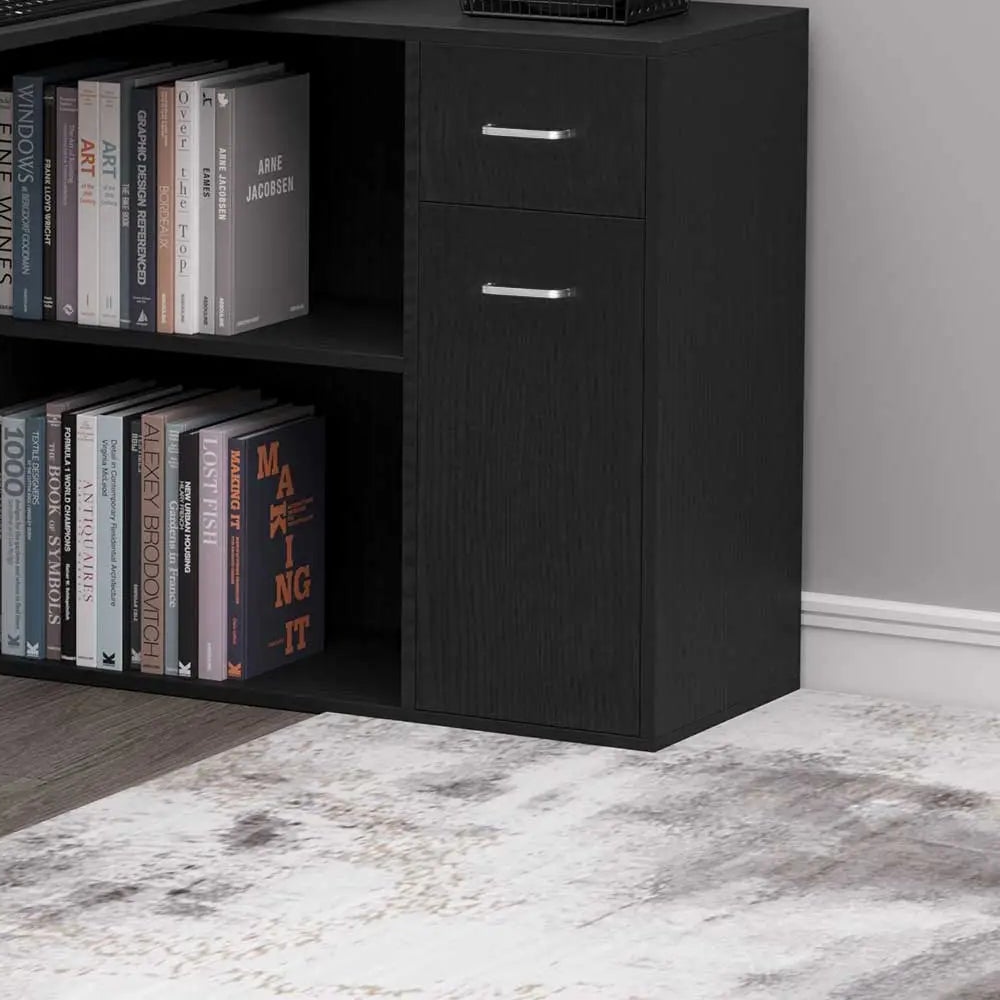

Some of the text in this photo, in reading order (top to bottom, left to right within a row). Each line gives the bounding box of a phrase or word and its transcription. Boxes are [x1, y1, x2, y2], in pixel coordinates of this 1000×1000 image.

[17, 84, 34, 183] WINDOWS
[81, 139, 96, 177] ART
[136, 110, 147, 161] GRAPHIC
[102, 140, 117, 179] ART
[178, 90, 189, 273] Over the Top
[202, 168, 211, 198] EAMES
[218, 147, 227, 221] ARNE JACOBSEN
[258, 154, 283, 176] ARNE
[43, 159, 52, 246] FRANK LLOYD WRIGHT
[121, 184, 130, 195] THE
[136, 165, 147, 207] DESIGN
[246, 176, 294, 203] JACOBSEN
[159, 185, 169, 249] BORDEAUX
[21, 234, 31, 275] GOODMAN
[136, 210, 147, 285] REFERENCED
[4, 427, 25, 497] 1000
[31, 431, 40, 505] TEXTILE DESIGNERS
[63, 427, 71, 466] FORMULA
[99, 439, 109, 497] Virginia McLeod
[110, 439, 118, 459] Detail
[48, 465, 60, 516] BOOK
[63, 474, 71, 503] WORLD
[108, 470, 118, 520] Contemporary
[202, 437, 218, 545] LOST FISH
[230, 450, 241, 510] MAKING
[63, 505, 71, 552] CHAMPIONS
[80, 480, 94, 603] ANTIQUAIRES
[110, 523, 118, 562] Residential
[143, 423, 160, 657] ALEXEY BRODOVITCH
[183, 481, 191, 573] NEW URBAN HOUSING
[230, 513, 241, 530] IT
[168, 500, 178, 608] Gardens in France
[48, 535, 61, 625] SYMBOLS
[110, 564, 118, 607] Architecture
[284, 614, 311, 656] IT
